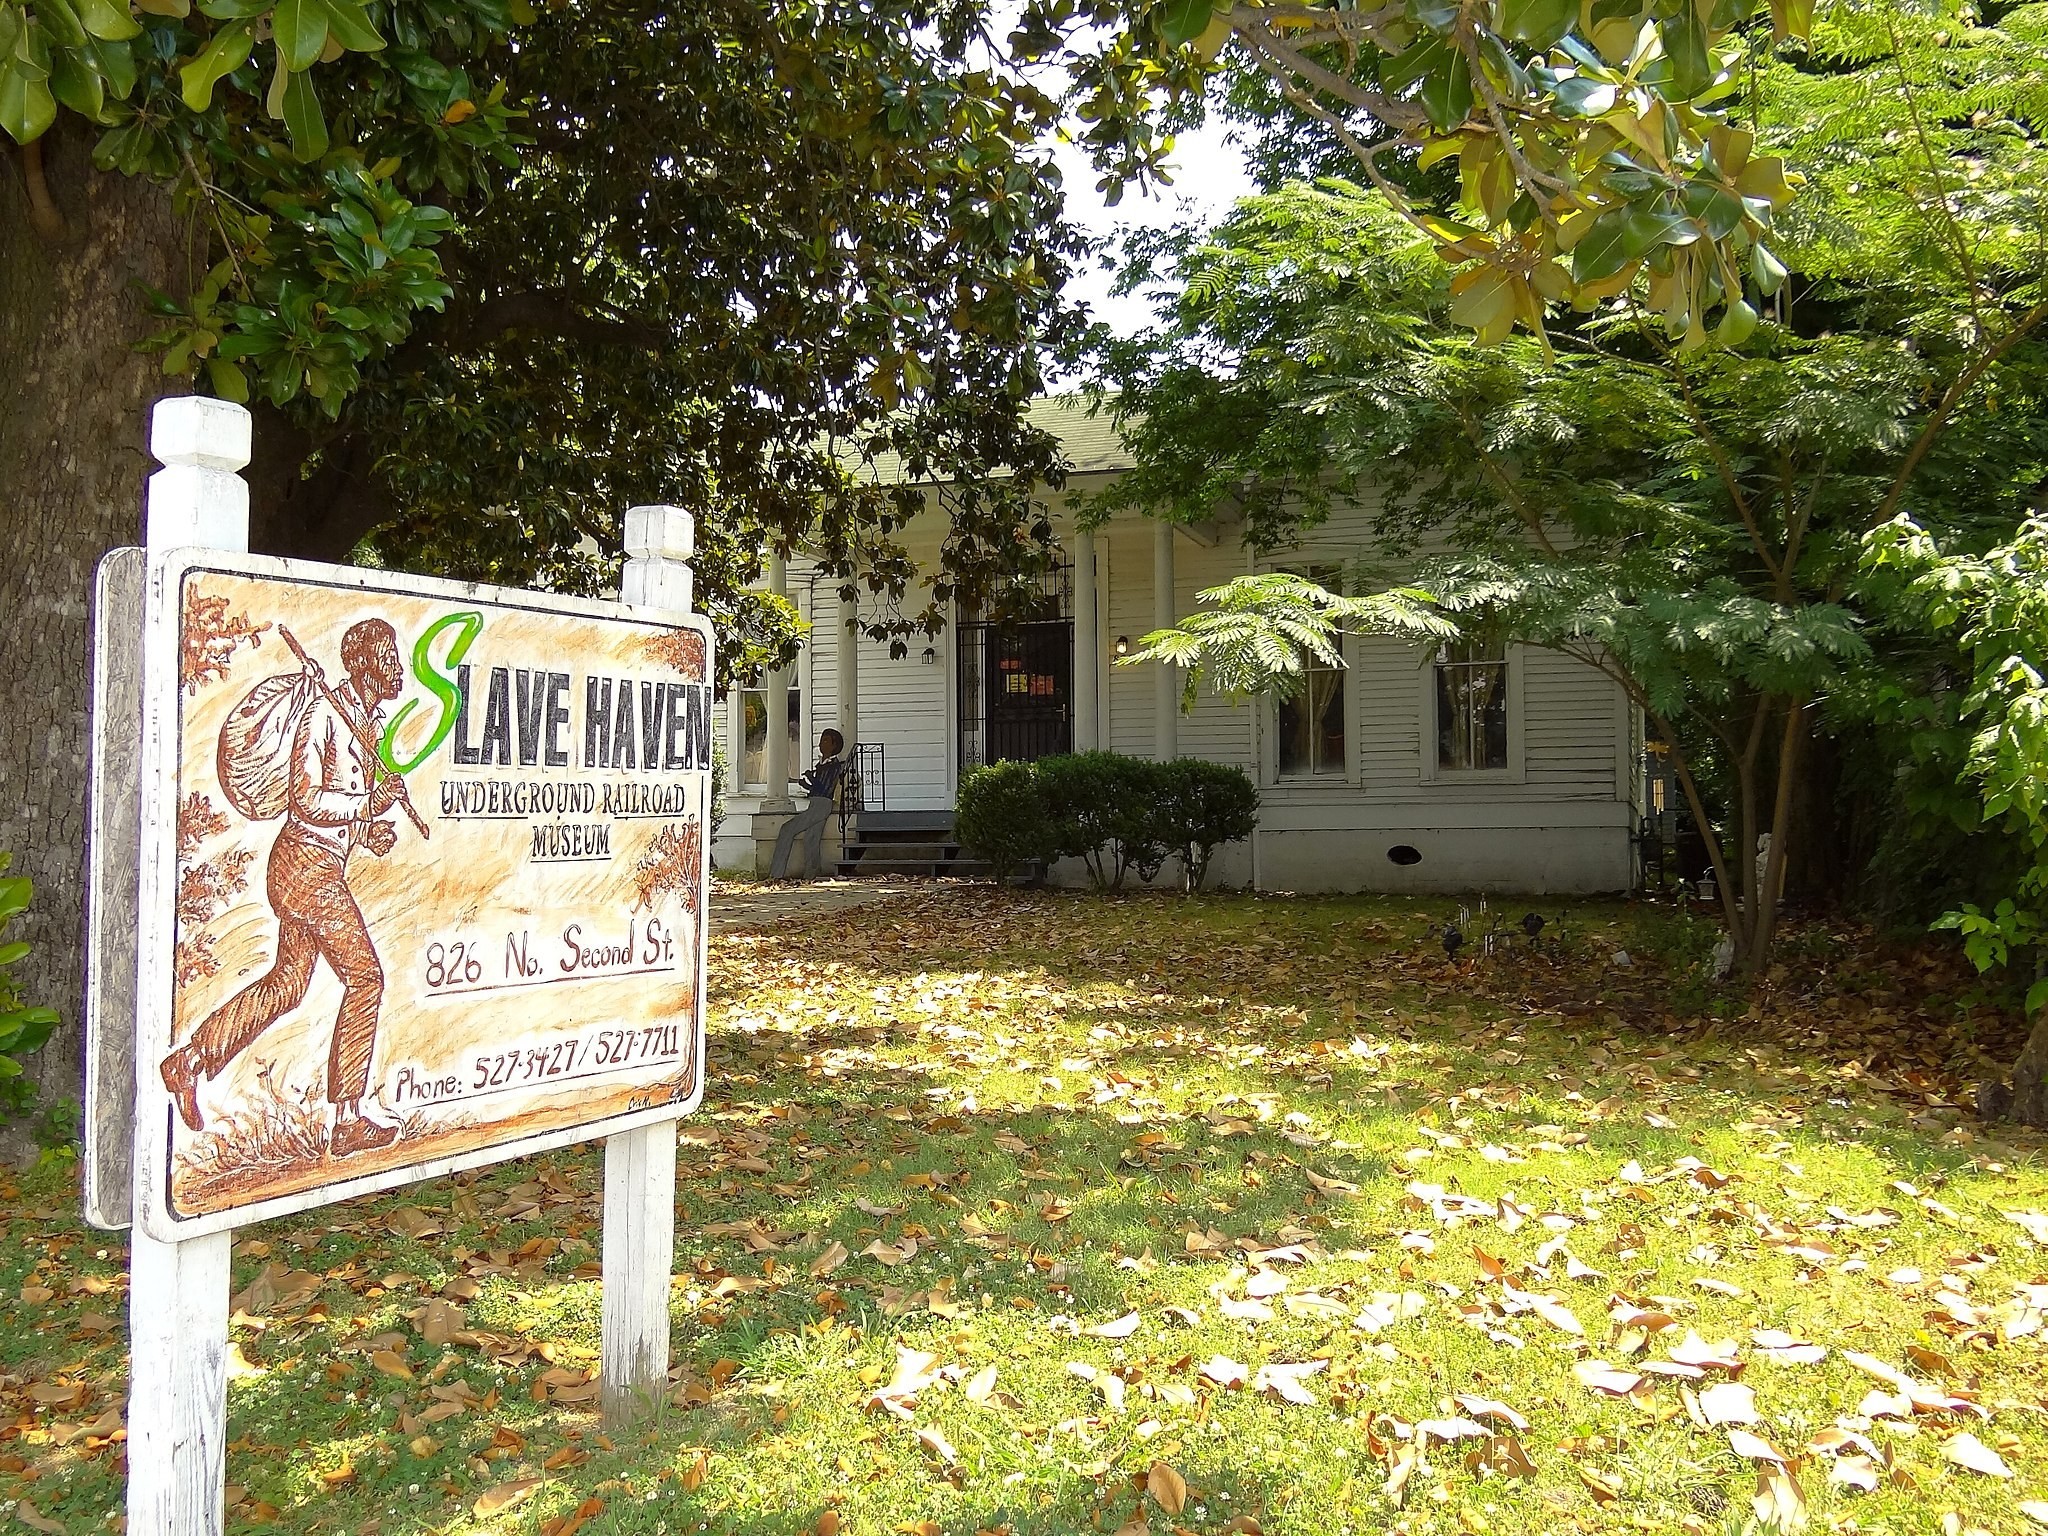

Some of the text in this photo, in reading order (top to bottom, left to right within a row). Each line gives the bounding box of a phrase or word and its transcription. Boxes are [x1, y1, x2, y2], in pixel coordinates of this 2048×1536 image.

[378, 611, 712, 782] SLAVE HAVEN
[440, 781, 685, 815] UNDERGROUND RAILROAD
[531, 824, 612, 857] MUSEUM
[426, 918, 674, 988] 826 No. Second St.
[395, 1067, 462, 1102] Phone:
